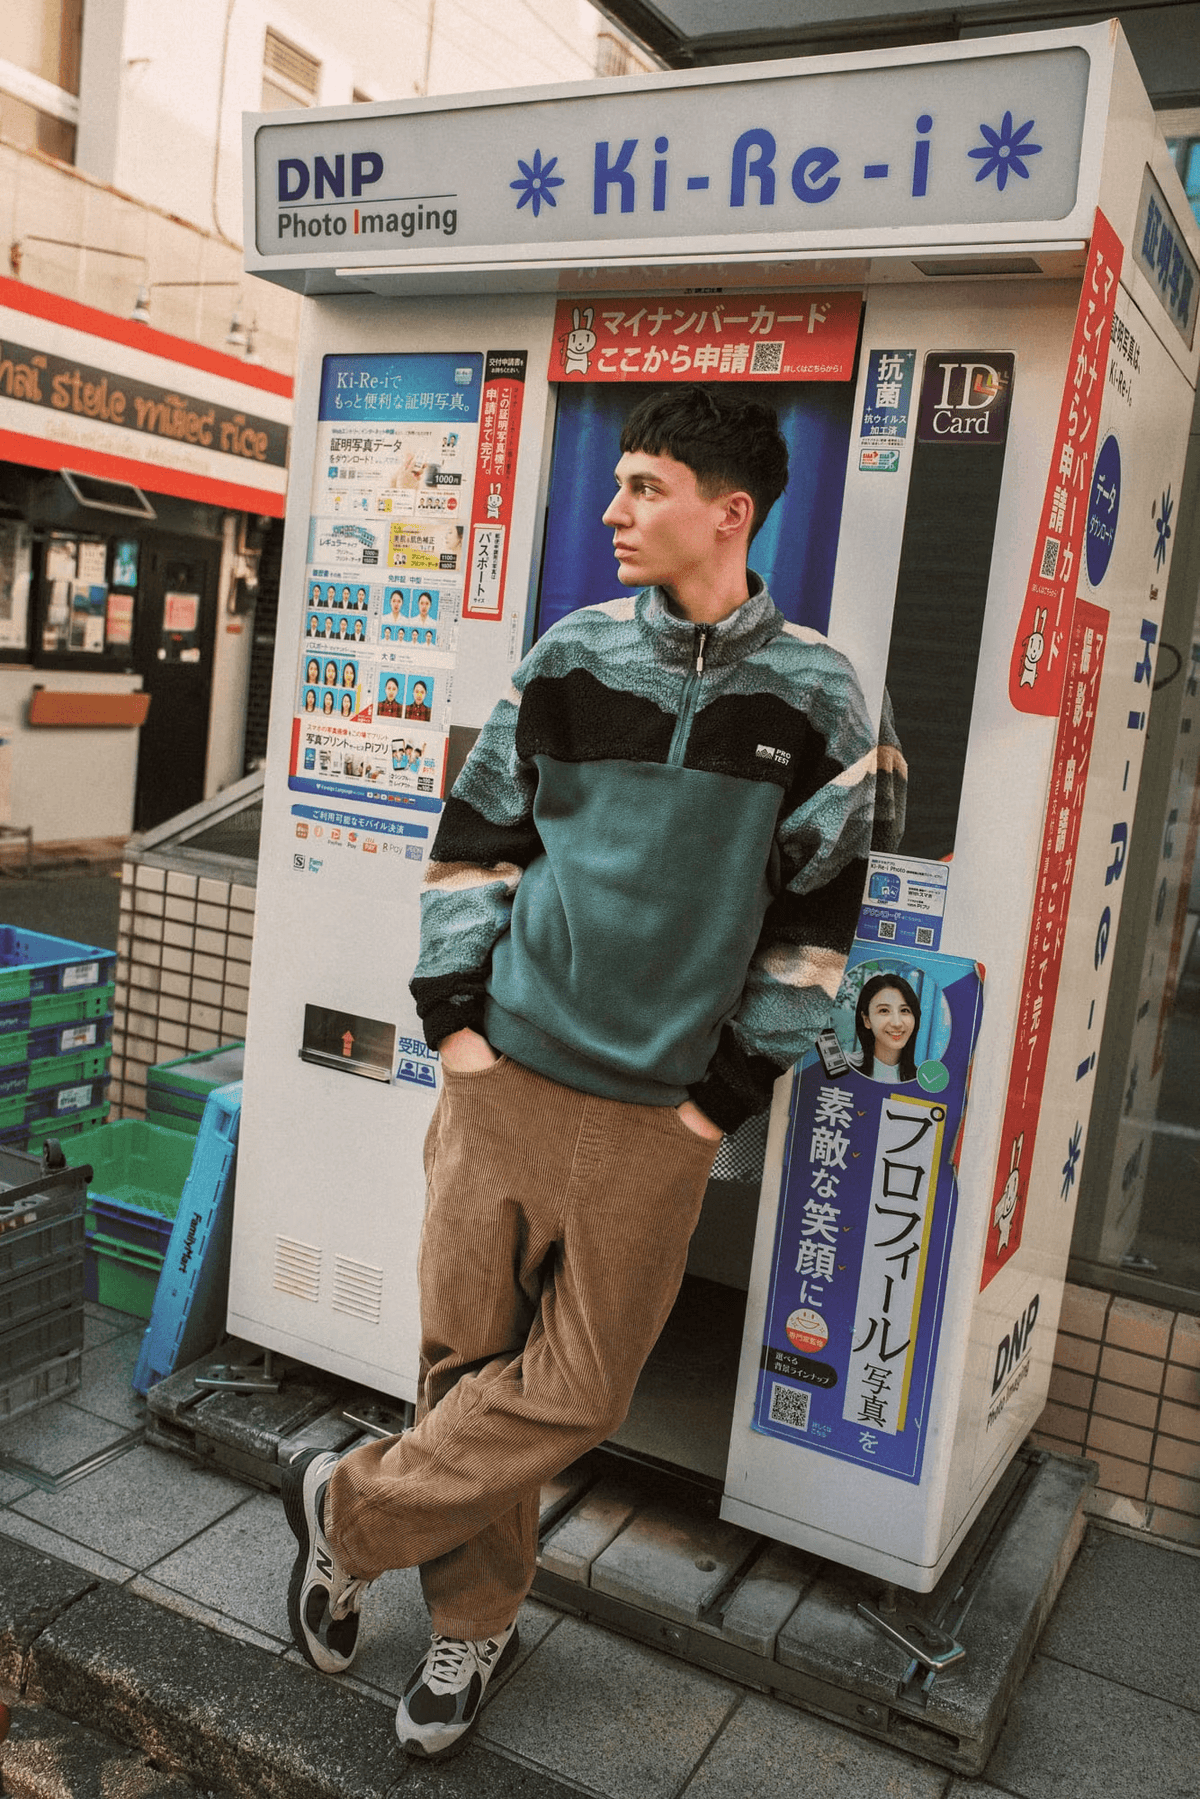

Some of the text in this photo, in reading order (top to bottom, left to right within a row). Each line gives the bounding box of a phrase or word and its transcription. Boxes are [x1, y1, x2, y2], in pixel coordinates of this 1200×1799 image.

[278, 152, 384, 203] DNP
[593, 115, 934, 214] Ki-Re-i
[278, 205, 458, 239] Photo Imaging
[602, 302, 831, 337] マイナンバーカード
[597, 343, 750, 375] ここから申請
[336, 371, 402, 389] Ki-Re-iで
[875, 354, 905, 409] 抗菌
[934, 363, 999, 410] ID
[1048, 250, 1104, 534] ここから申請
[334, 392, 470, 412] もっと便利な証明写真。
[864, 415, 907, 424] 抗ウイルス
[220, 413, 269, 461] rice
[480, 387, 498, 476] 申請まで完了。
[870, 426, 898, 435] 加工済
[932, 411, 990, 434] Card
[330, 438, 402, 452] 証明写真データ
[1047, 265, 1114, 672] マイナンバーカード
[1096, 474, 1116, 514] データ
[1089, 512, 1114, 547] ダウンロード
[477, 532, 492, 597] パスポート
[774, 754, 789, 766] TEST
[776, 749, 791, 760] PRO
[1052, 634, 1104, 961] マイナンバーカード
[312, 810, 405, 834] ご利用可能なモバイル決済
[1075, 618, 1158, 1083] Ki-Re-i
[794, 1086, 855, 1307] 素敵な笑顔に
[178, 1212, 202, 1274] FamilyMart
[775, 1352, 798, 1365] 選べる
[991, 1293, 1040, 1398] DNP
